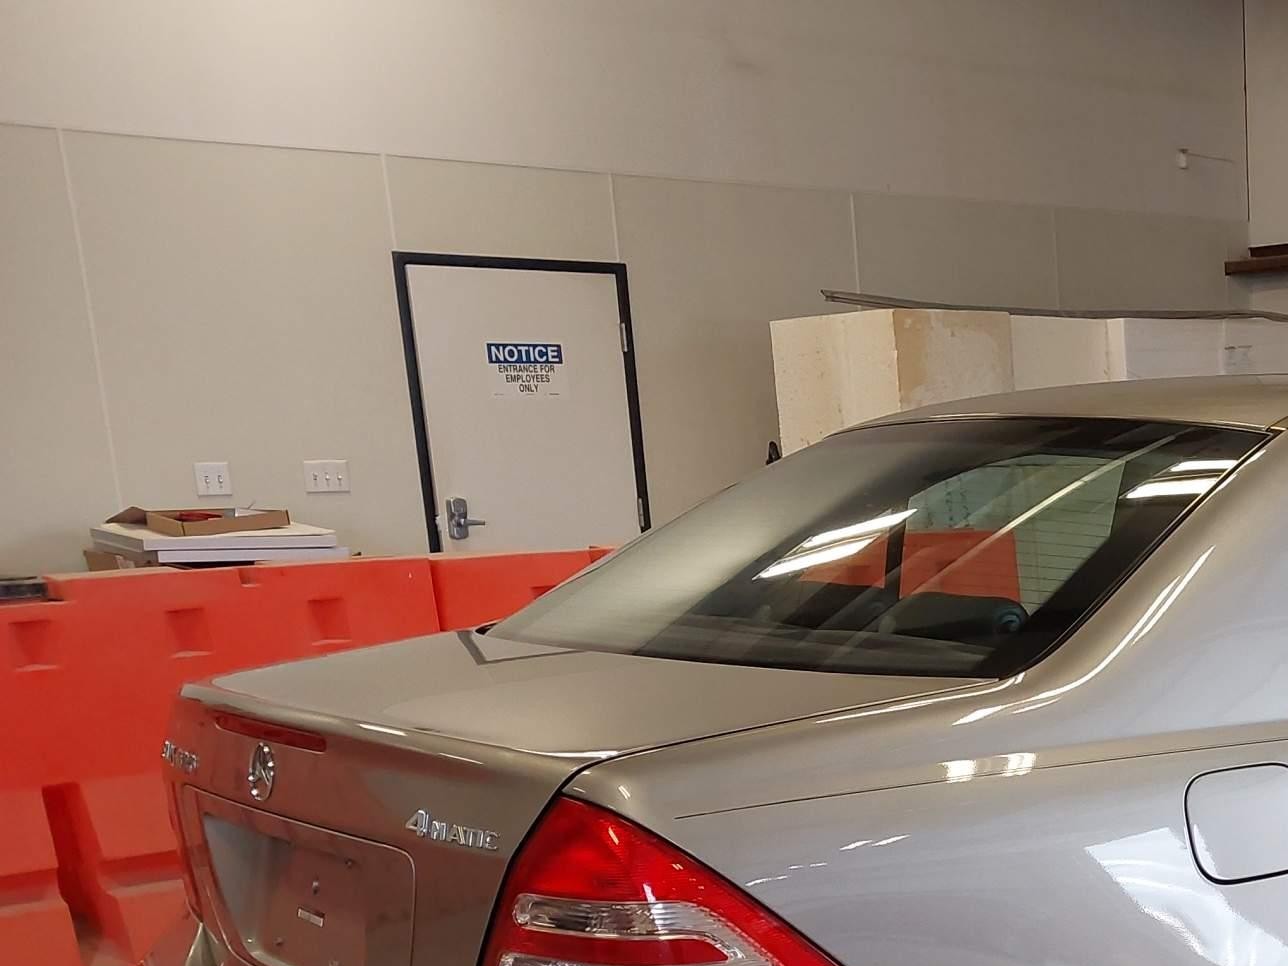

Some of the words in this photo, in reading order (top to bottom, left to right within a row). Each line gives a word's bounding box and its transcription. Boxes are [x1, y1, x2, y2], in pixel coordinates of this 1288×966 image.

[490, 346, 559, 362] NOTICE
[498, 364, 538, 374] ENTRANCE
[540, 365, 555, 374] FOR
[505, 374, 550, 383] EMPLOYEES
[519, 384, 539, 393] ONLY
